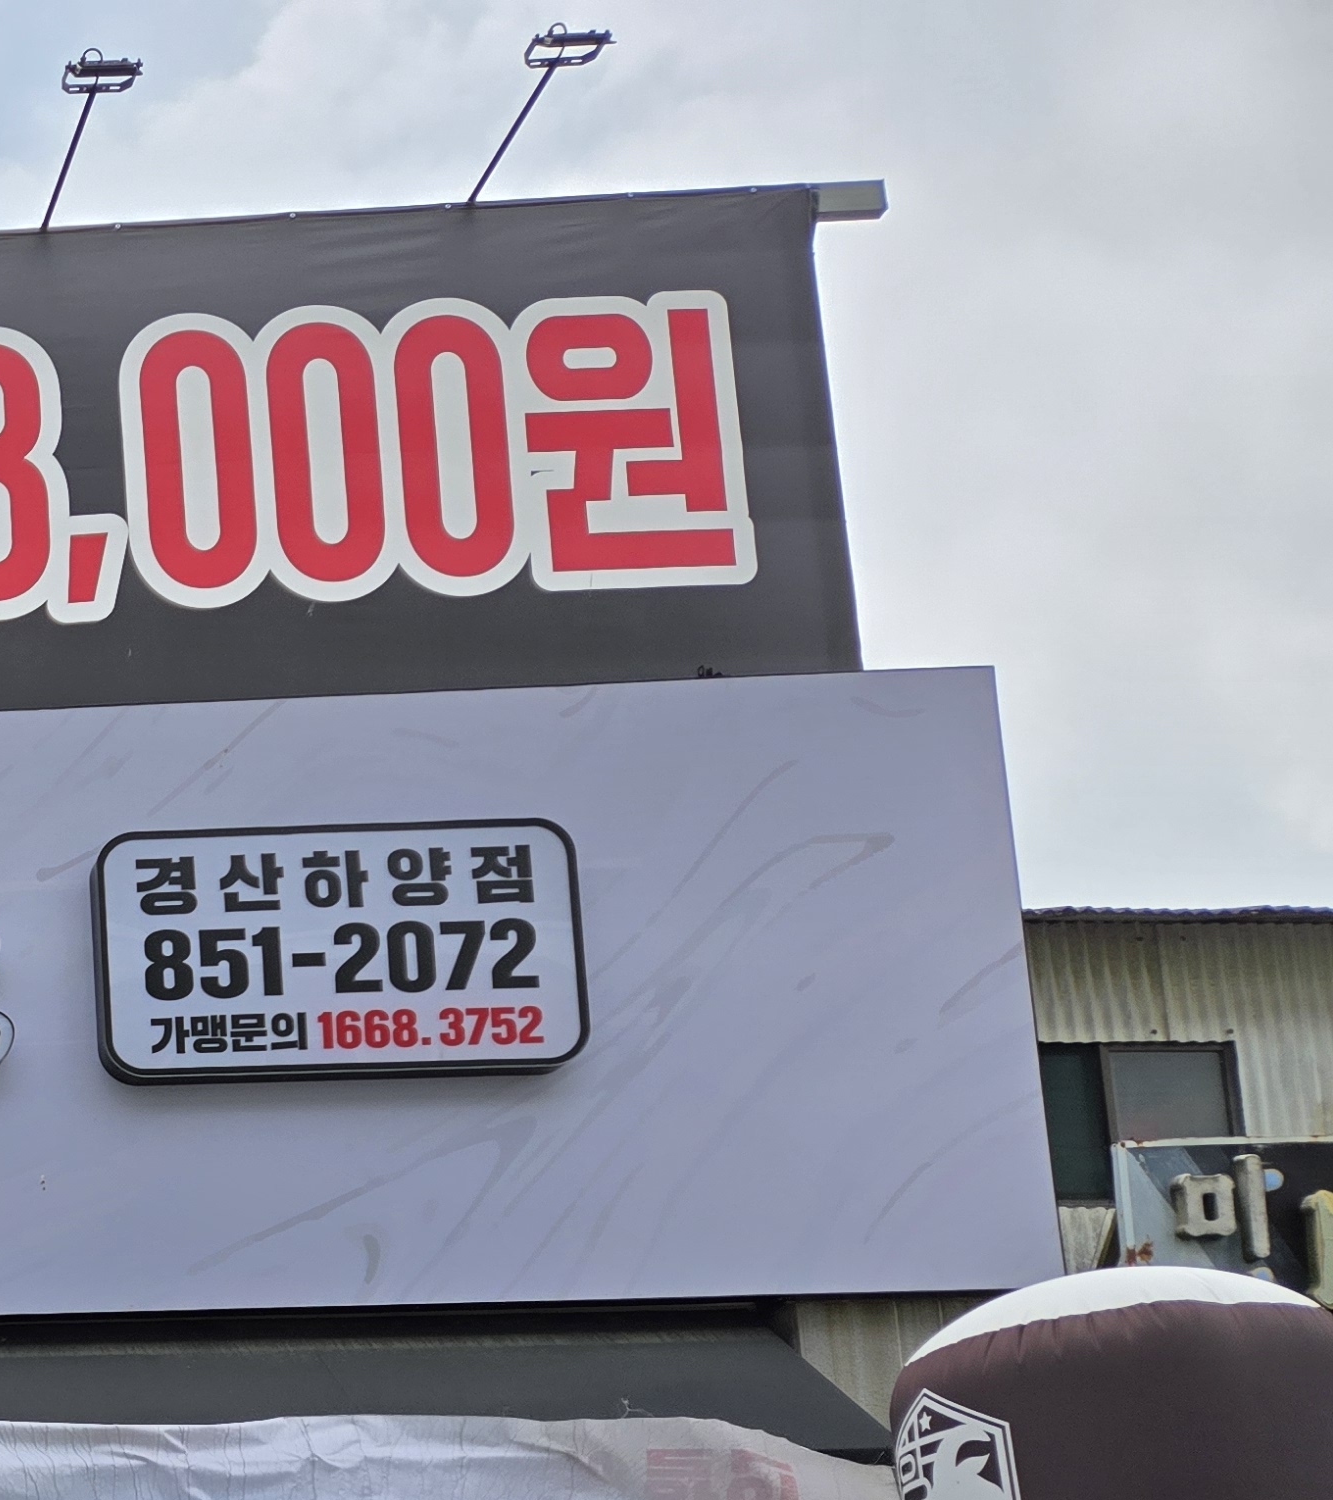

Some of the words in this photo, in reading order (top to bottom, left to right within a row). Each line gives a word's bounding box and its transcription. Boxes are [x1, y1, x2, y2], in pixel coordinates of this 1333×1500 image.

[144, 917, 540, 1001] 851-2072
[150, 1012, 309, 1055] 가맹문의
[318, 1005, 545, 1050] 1668.3752
